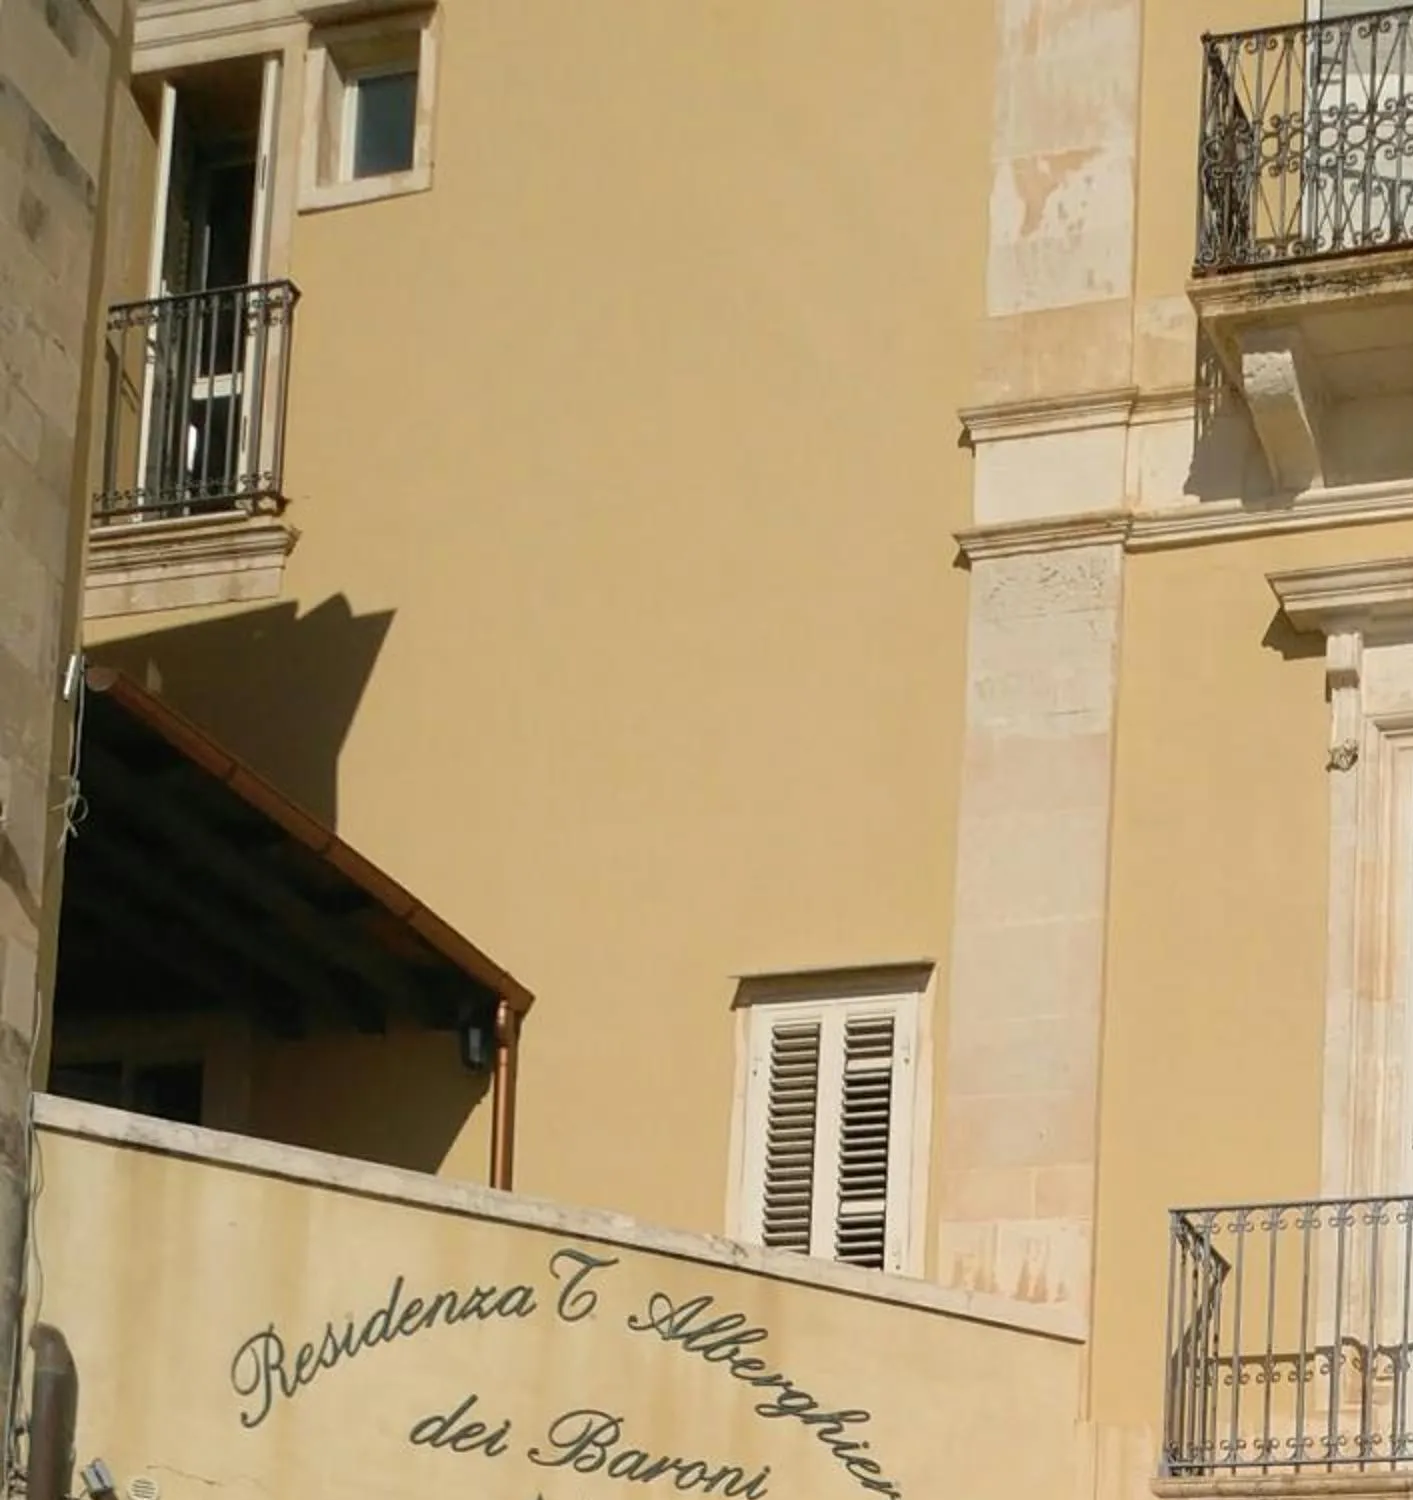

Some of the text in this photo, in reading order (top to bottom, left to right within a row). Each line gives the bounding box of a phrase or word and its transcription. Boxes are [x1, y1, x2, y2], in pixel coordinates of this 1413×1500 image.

[231, 1275, 538, 1429] Residenza
[409, 1394, 771, 1500] dei Baroni
